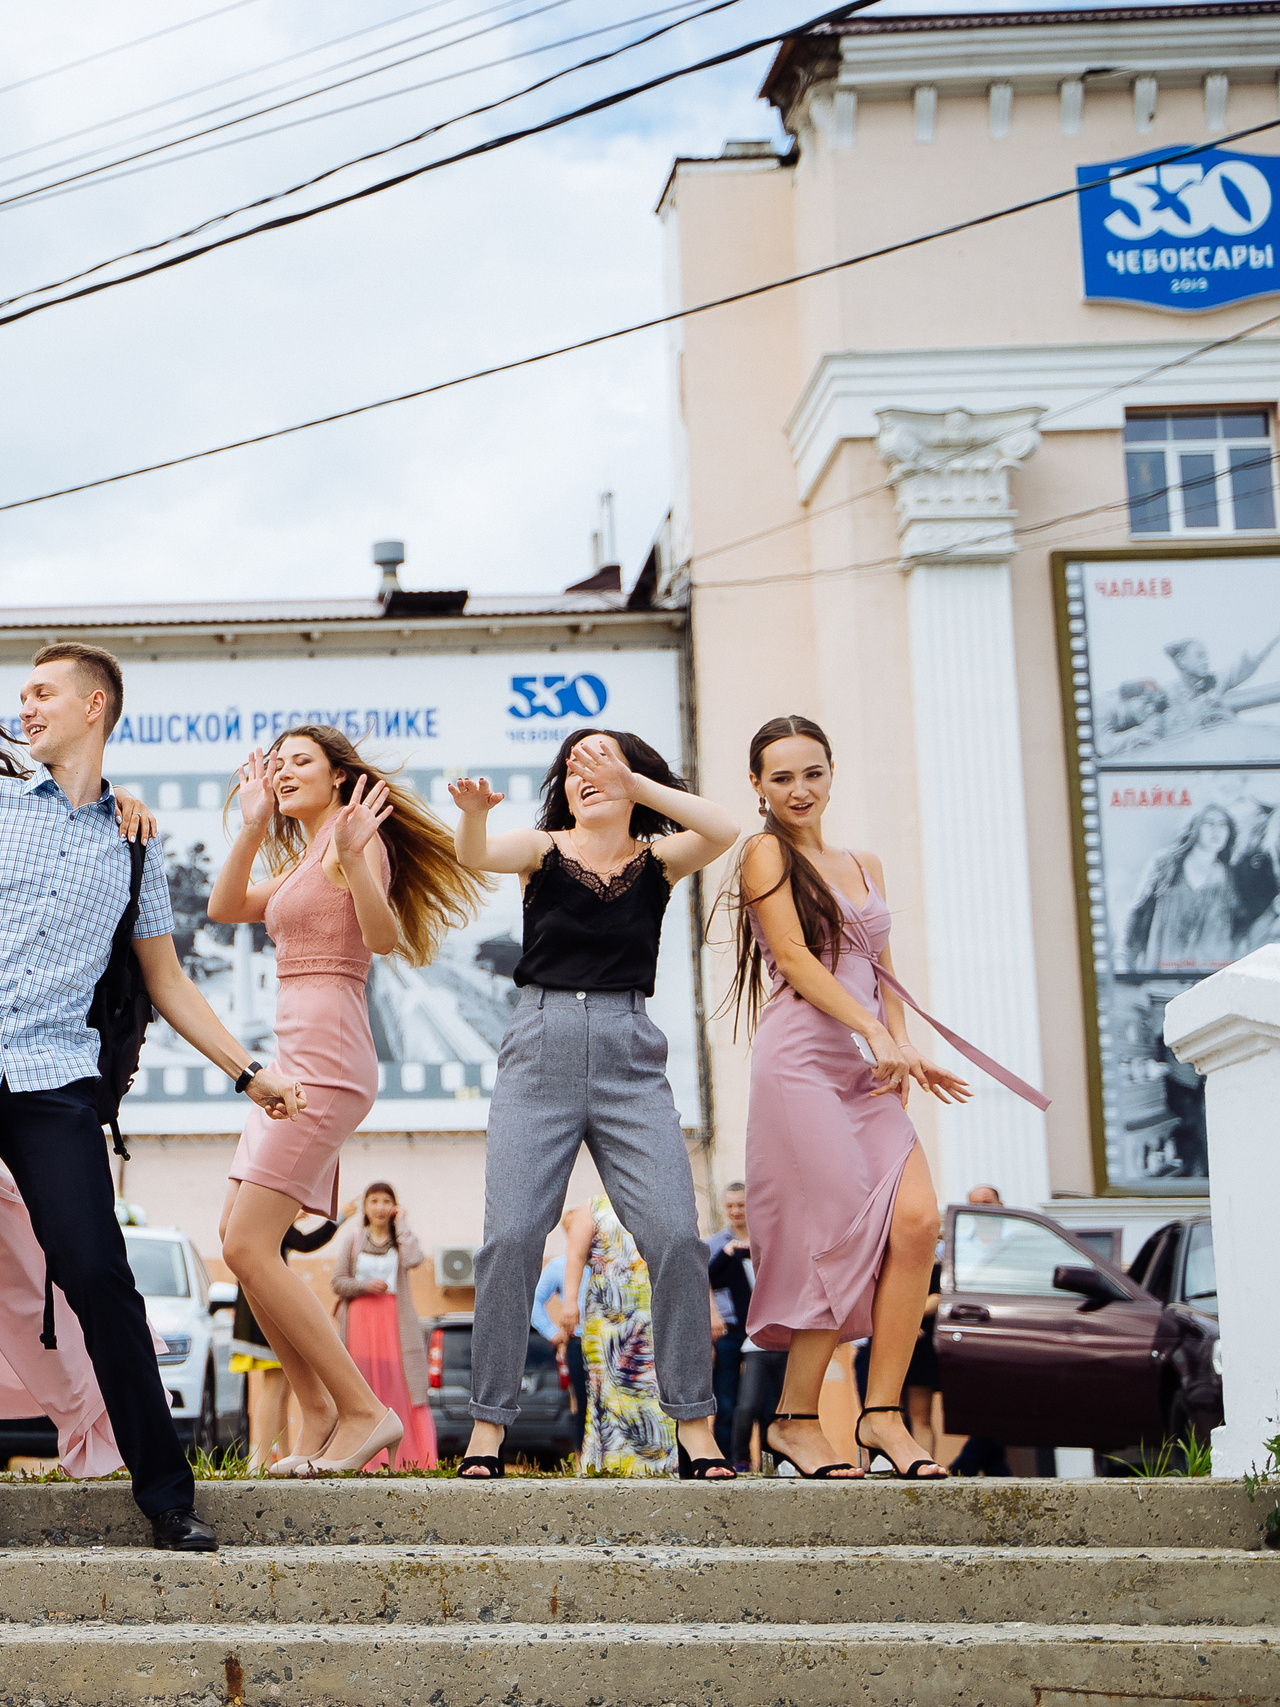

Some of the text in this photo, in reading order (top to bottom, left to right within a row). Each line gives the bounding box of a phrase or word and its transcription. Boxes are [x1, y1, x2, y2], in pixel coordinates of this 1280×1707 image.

[1103, 160, 1273, 241] 550
[1106, 243, 1275, 275] ЧЕБОКСАРЫ
[1170, 276, 1209, 294] 2019
[1095, 577, 1173, 598] ЧАПАЕВ
[508, 674, 607, 718] 550
[107, 706, 241, 744] АШСКОЙ
[1110, 784, 1193, 807] АПАЙКА
